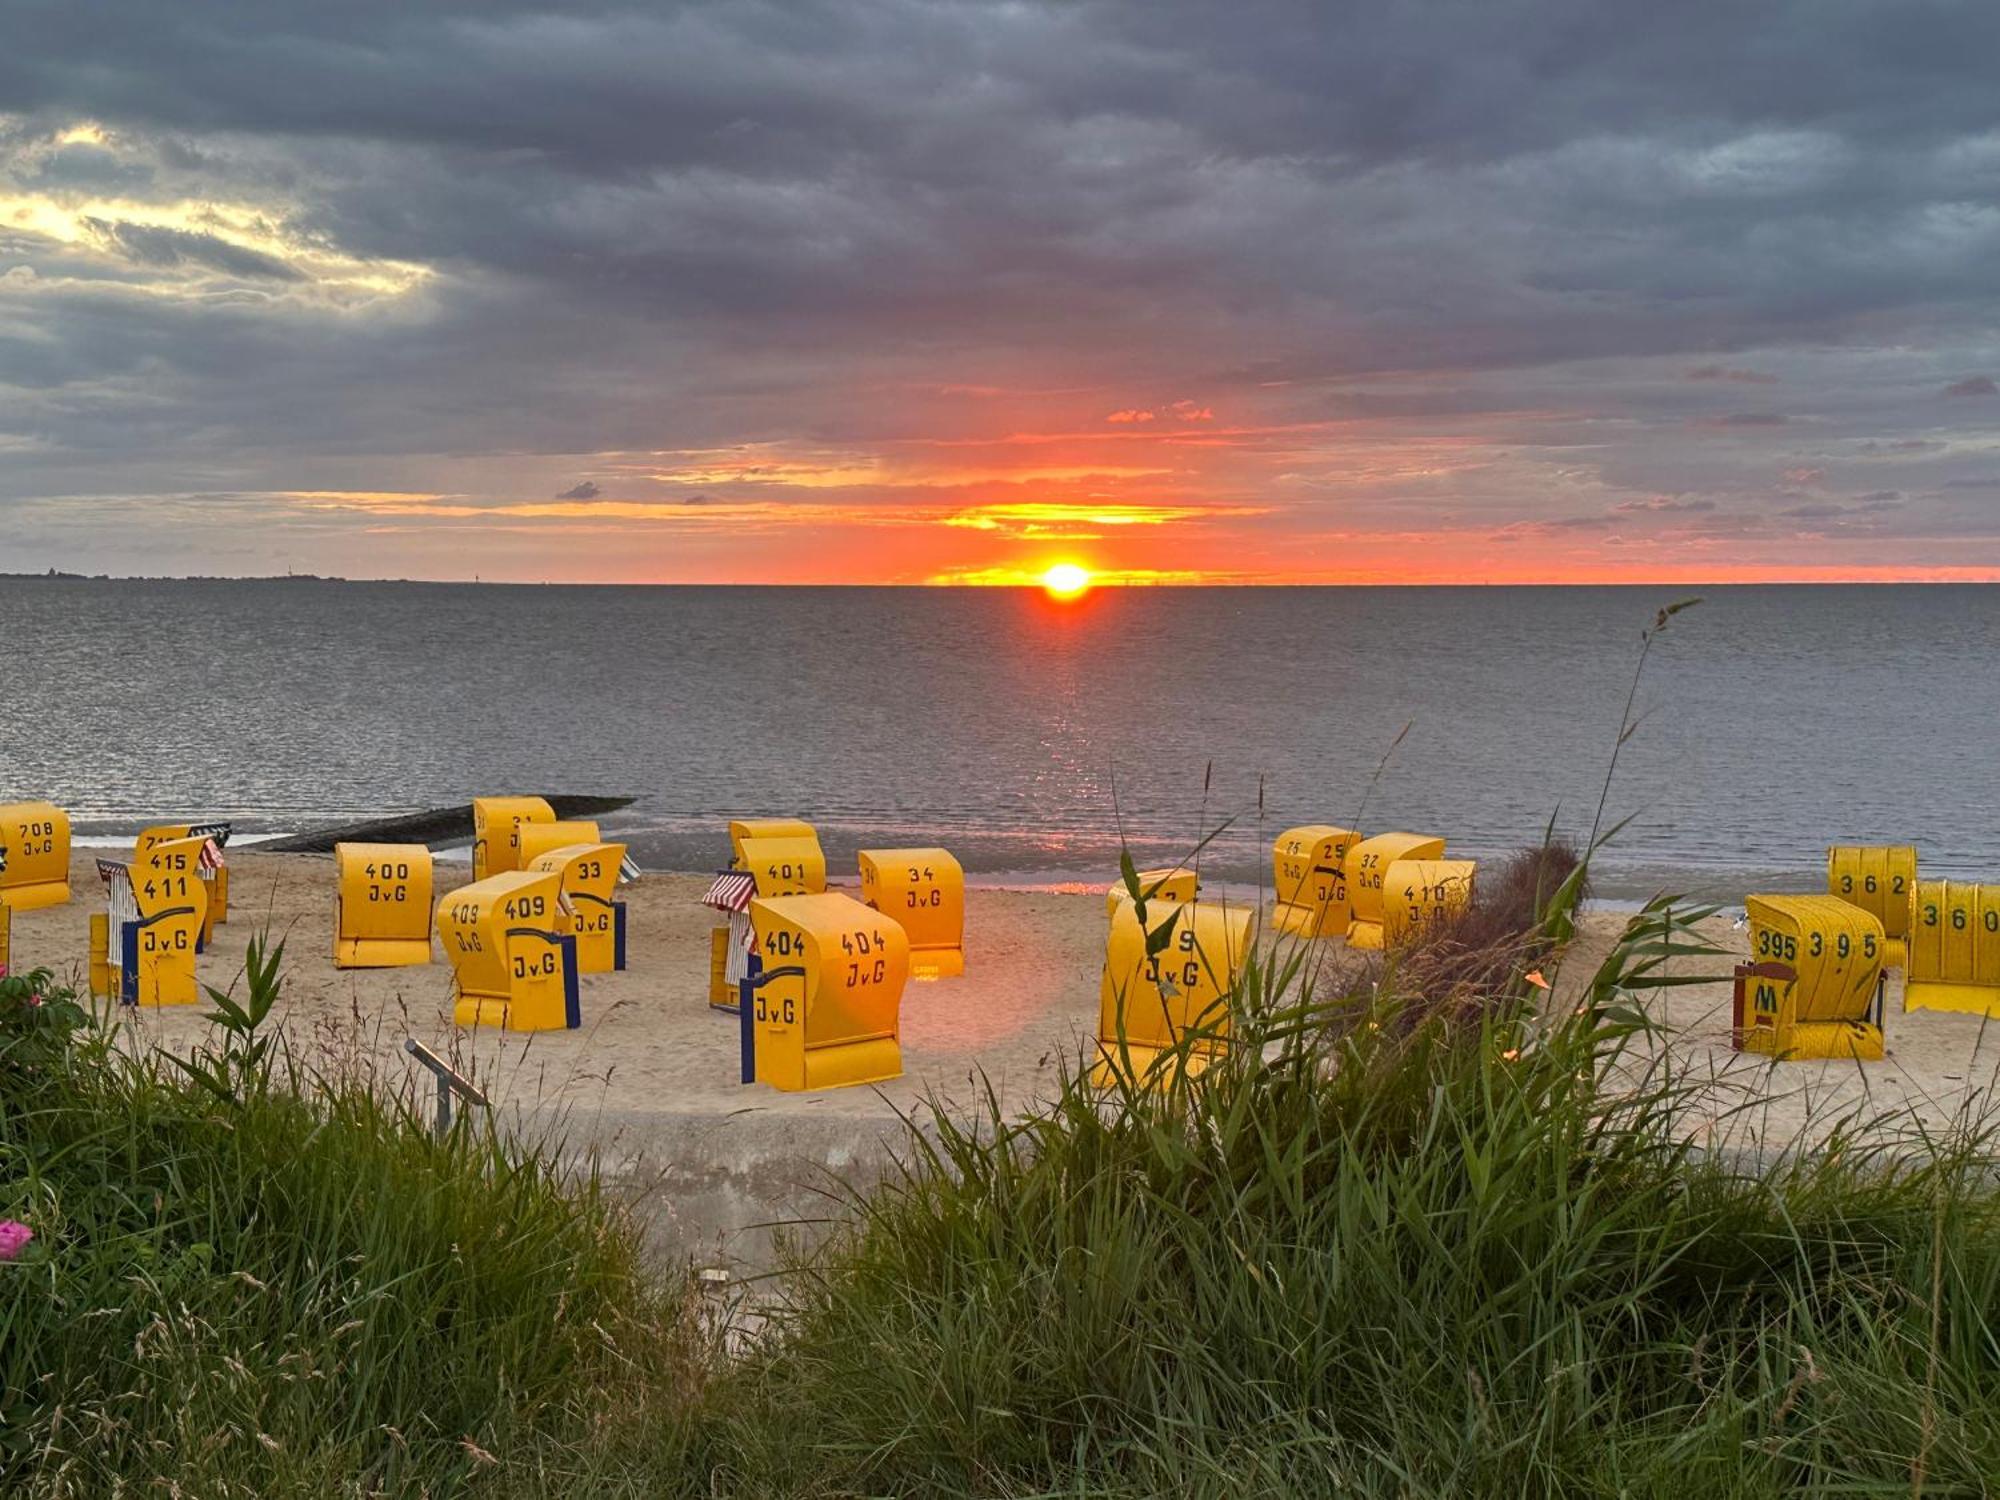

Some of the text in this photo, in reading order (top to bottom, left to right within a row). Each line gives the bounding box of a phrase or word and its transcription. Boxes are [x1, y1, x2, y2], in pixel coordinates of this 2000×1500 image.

[19, 822, 53, 838] 708
[1324, 843, 1344, 859] 25
[150, 854, 186, 870] 415
[578, 861, 601, 880] 33
[1361, 854, 1379, 869] 32
[365, 863, 408, 880] 400
[768, 864, 804, 879] 401
[908, 867, 934, 882] 34
[144, 876, 186, 899] 411
[1841, 876, 1904, 894] 362
[505, 896, 545, 921] 409
[1924, 906, 1999, 932] 360
[766, 931, 804, 956] 404
[842, 930, 884, 956] 404
[1759, 930, 1796, 961] 395
[1810, 931, 1876, 959] 395
[1754, 985, 1777, 1014] M
